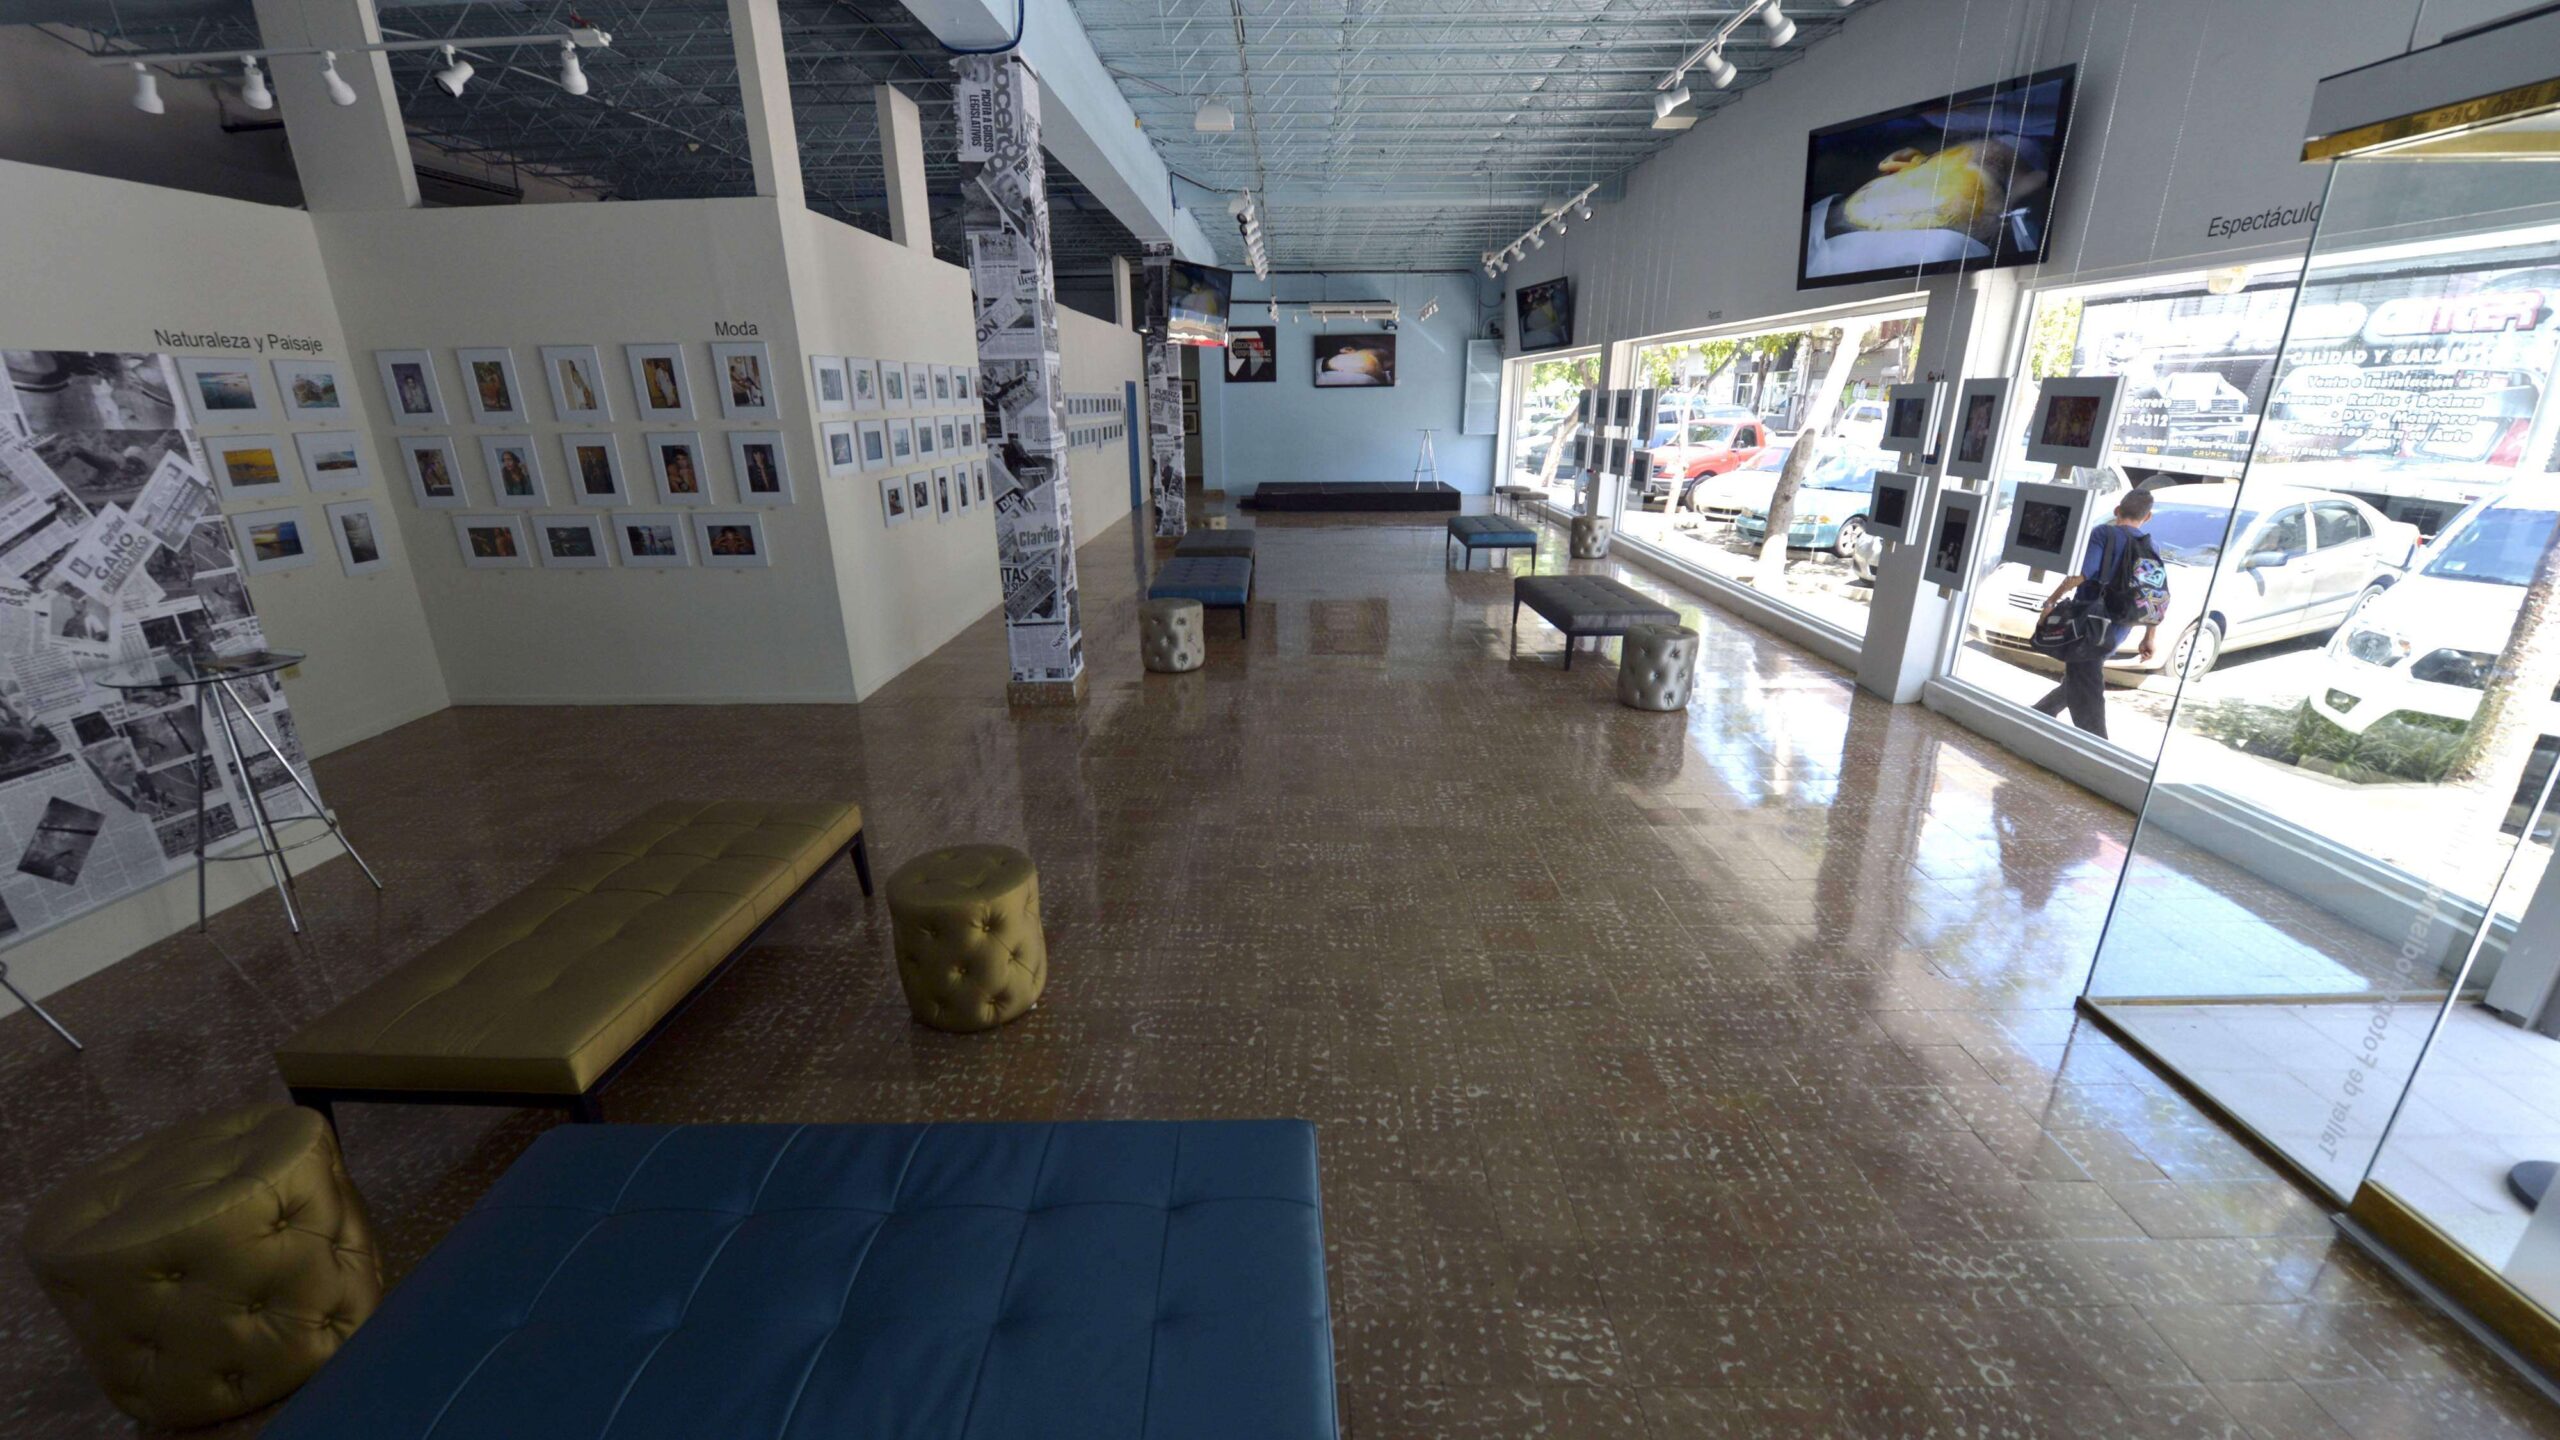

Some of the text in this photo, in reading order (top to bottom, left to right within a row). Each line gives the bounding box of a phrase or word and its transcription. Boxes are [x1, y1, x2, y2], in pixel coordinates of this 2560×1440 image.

[715, 320, 758, 337] Moda
[154, 328, 323, 354] Naturaleza y Paisaje
[2289, 349, 2369, 367] CALIDAD
[2373, 350, 2387, 364] Y
[2346, 393, 2400, 408] Radios
[2416, 393, 2485, 410] Bocinas
[2342, 409, 2480, 427] DVD Monitores
[2431, 427, 2474, 444] Auto
[94, 532, 134, 580] GANO
